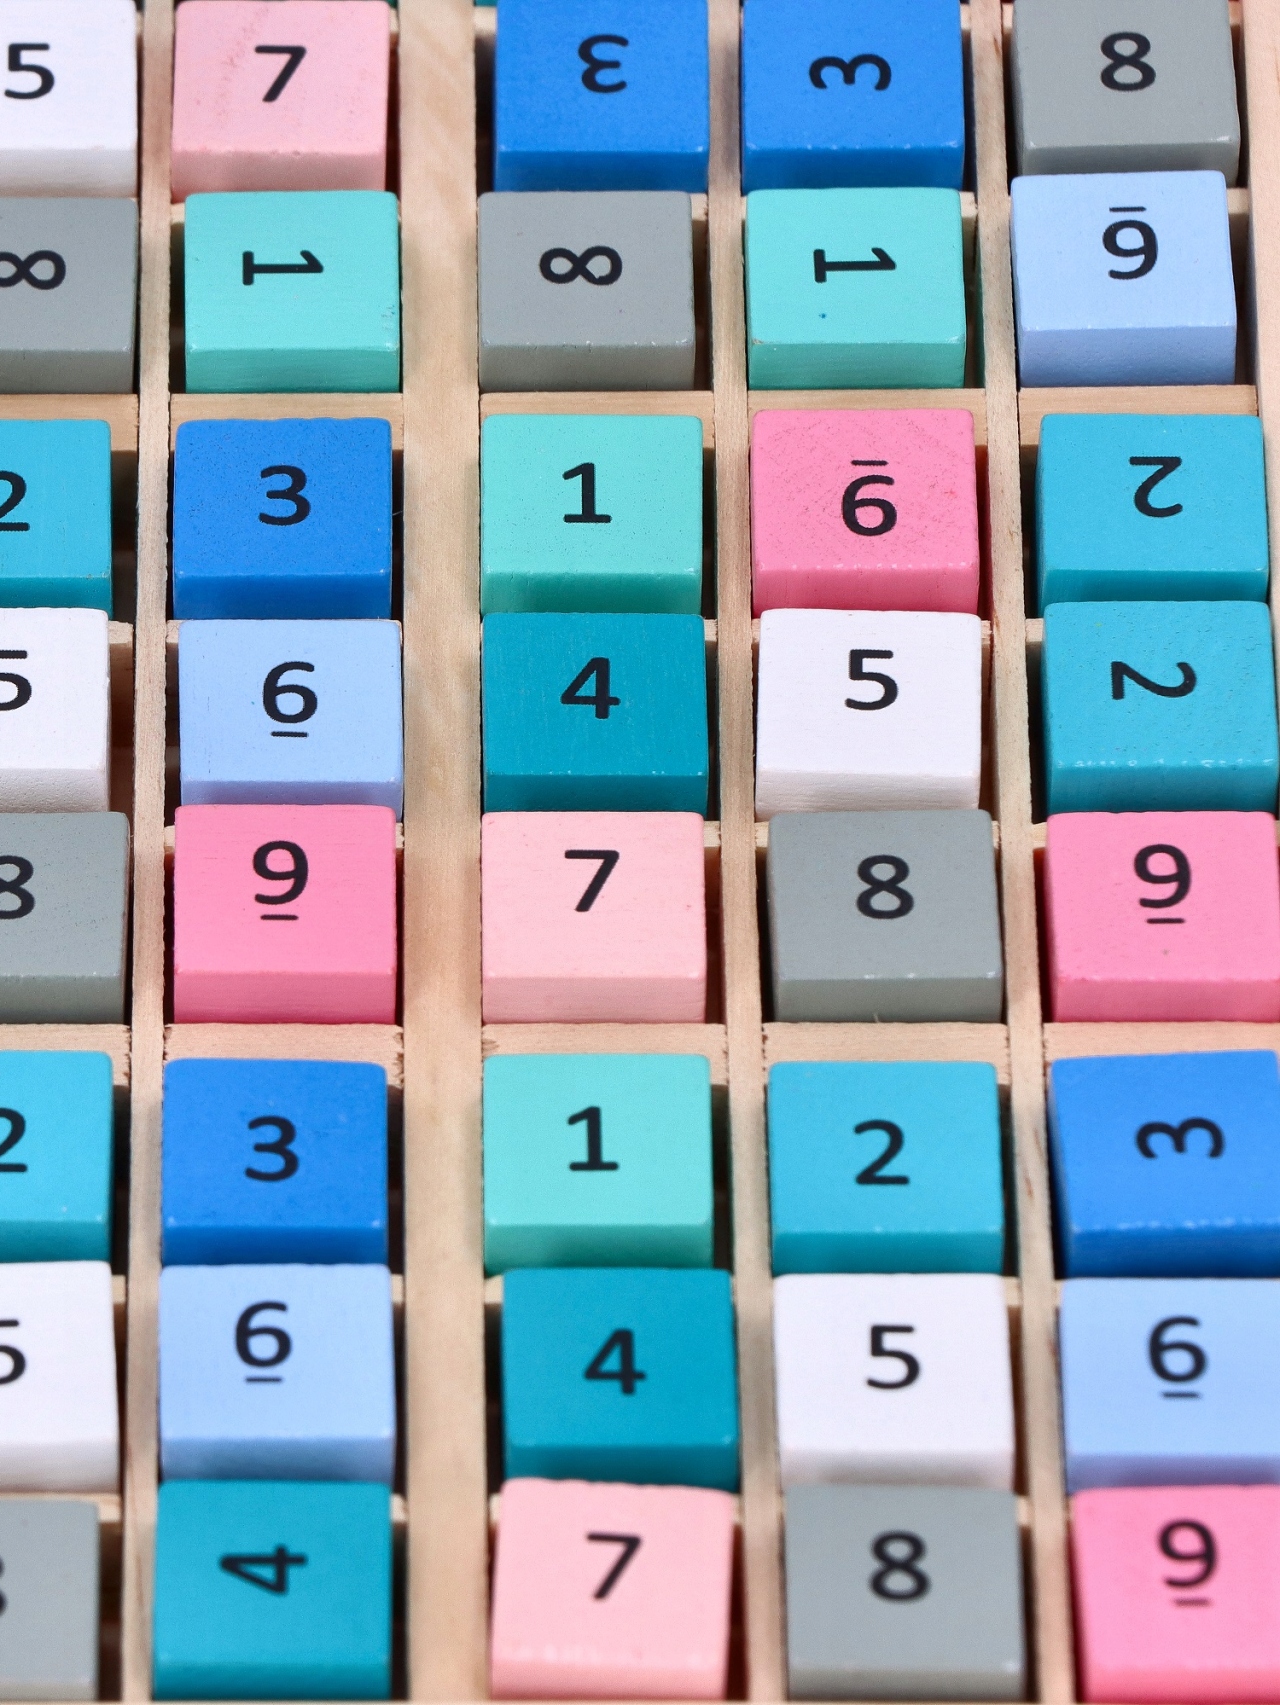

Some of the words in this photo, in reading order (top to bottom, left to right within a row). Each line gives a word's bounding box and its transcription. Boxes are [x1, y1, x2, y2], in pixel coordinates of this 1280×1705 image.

[5, 44, 54, 99] 5
[255, 46, 306, 102] 7
[578, 35, 628, 93] 3
[809, 54, 891, 90] 3
[1101, 32, 1156, 91] 8
[243, 251, 323, 285] 1
[539, 246, 622, 285] 8
[814, 248, 895, 283] 1
[259, 465, 310, 526] 3
[563, 463, 611, 523] 1
[1130, 457, 1182, 517] 2
[263, 662, 317, 737] 6
[561, 657, 620, 719] 4
[845, 649, 897, 710] 5
[1111, 662, 1196, 700] 2
[253, 841, 308, 920] 9
[565, 850, 619, 912] 7
[857, 855, 913, 919] 8
[1134, 844, 1190, 923] 9
[246, 1116, 298, 1181] 3
[568, 1107, 618, 1171] 1
[855, 1120, 909, 1185] 2
[1136, 1118, 1223, 1158] 3
[236, 1302, 290, 1382] 6
[585, 1330, 645, 1394] 4
[867, 1325, 919, 1389] 5
[1149, 1317, 1205, 1397] 6
[221, 1547, 306, 1594] 4
[588, 1534, 640, 1599] 7
[871, 1532, 929, 1601] 8
[1159, 1521, 1216, 1606] 9
